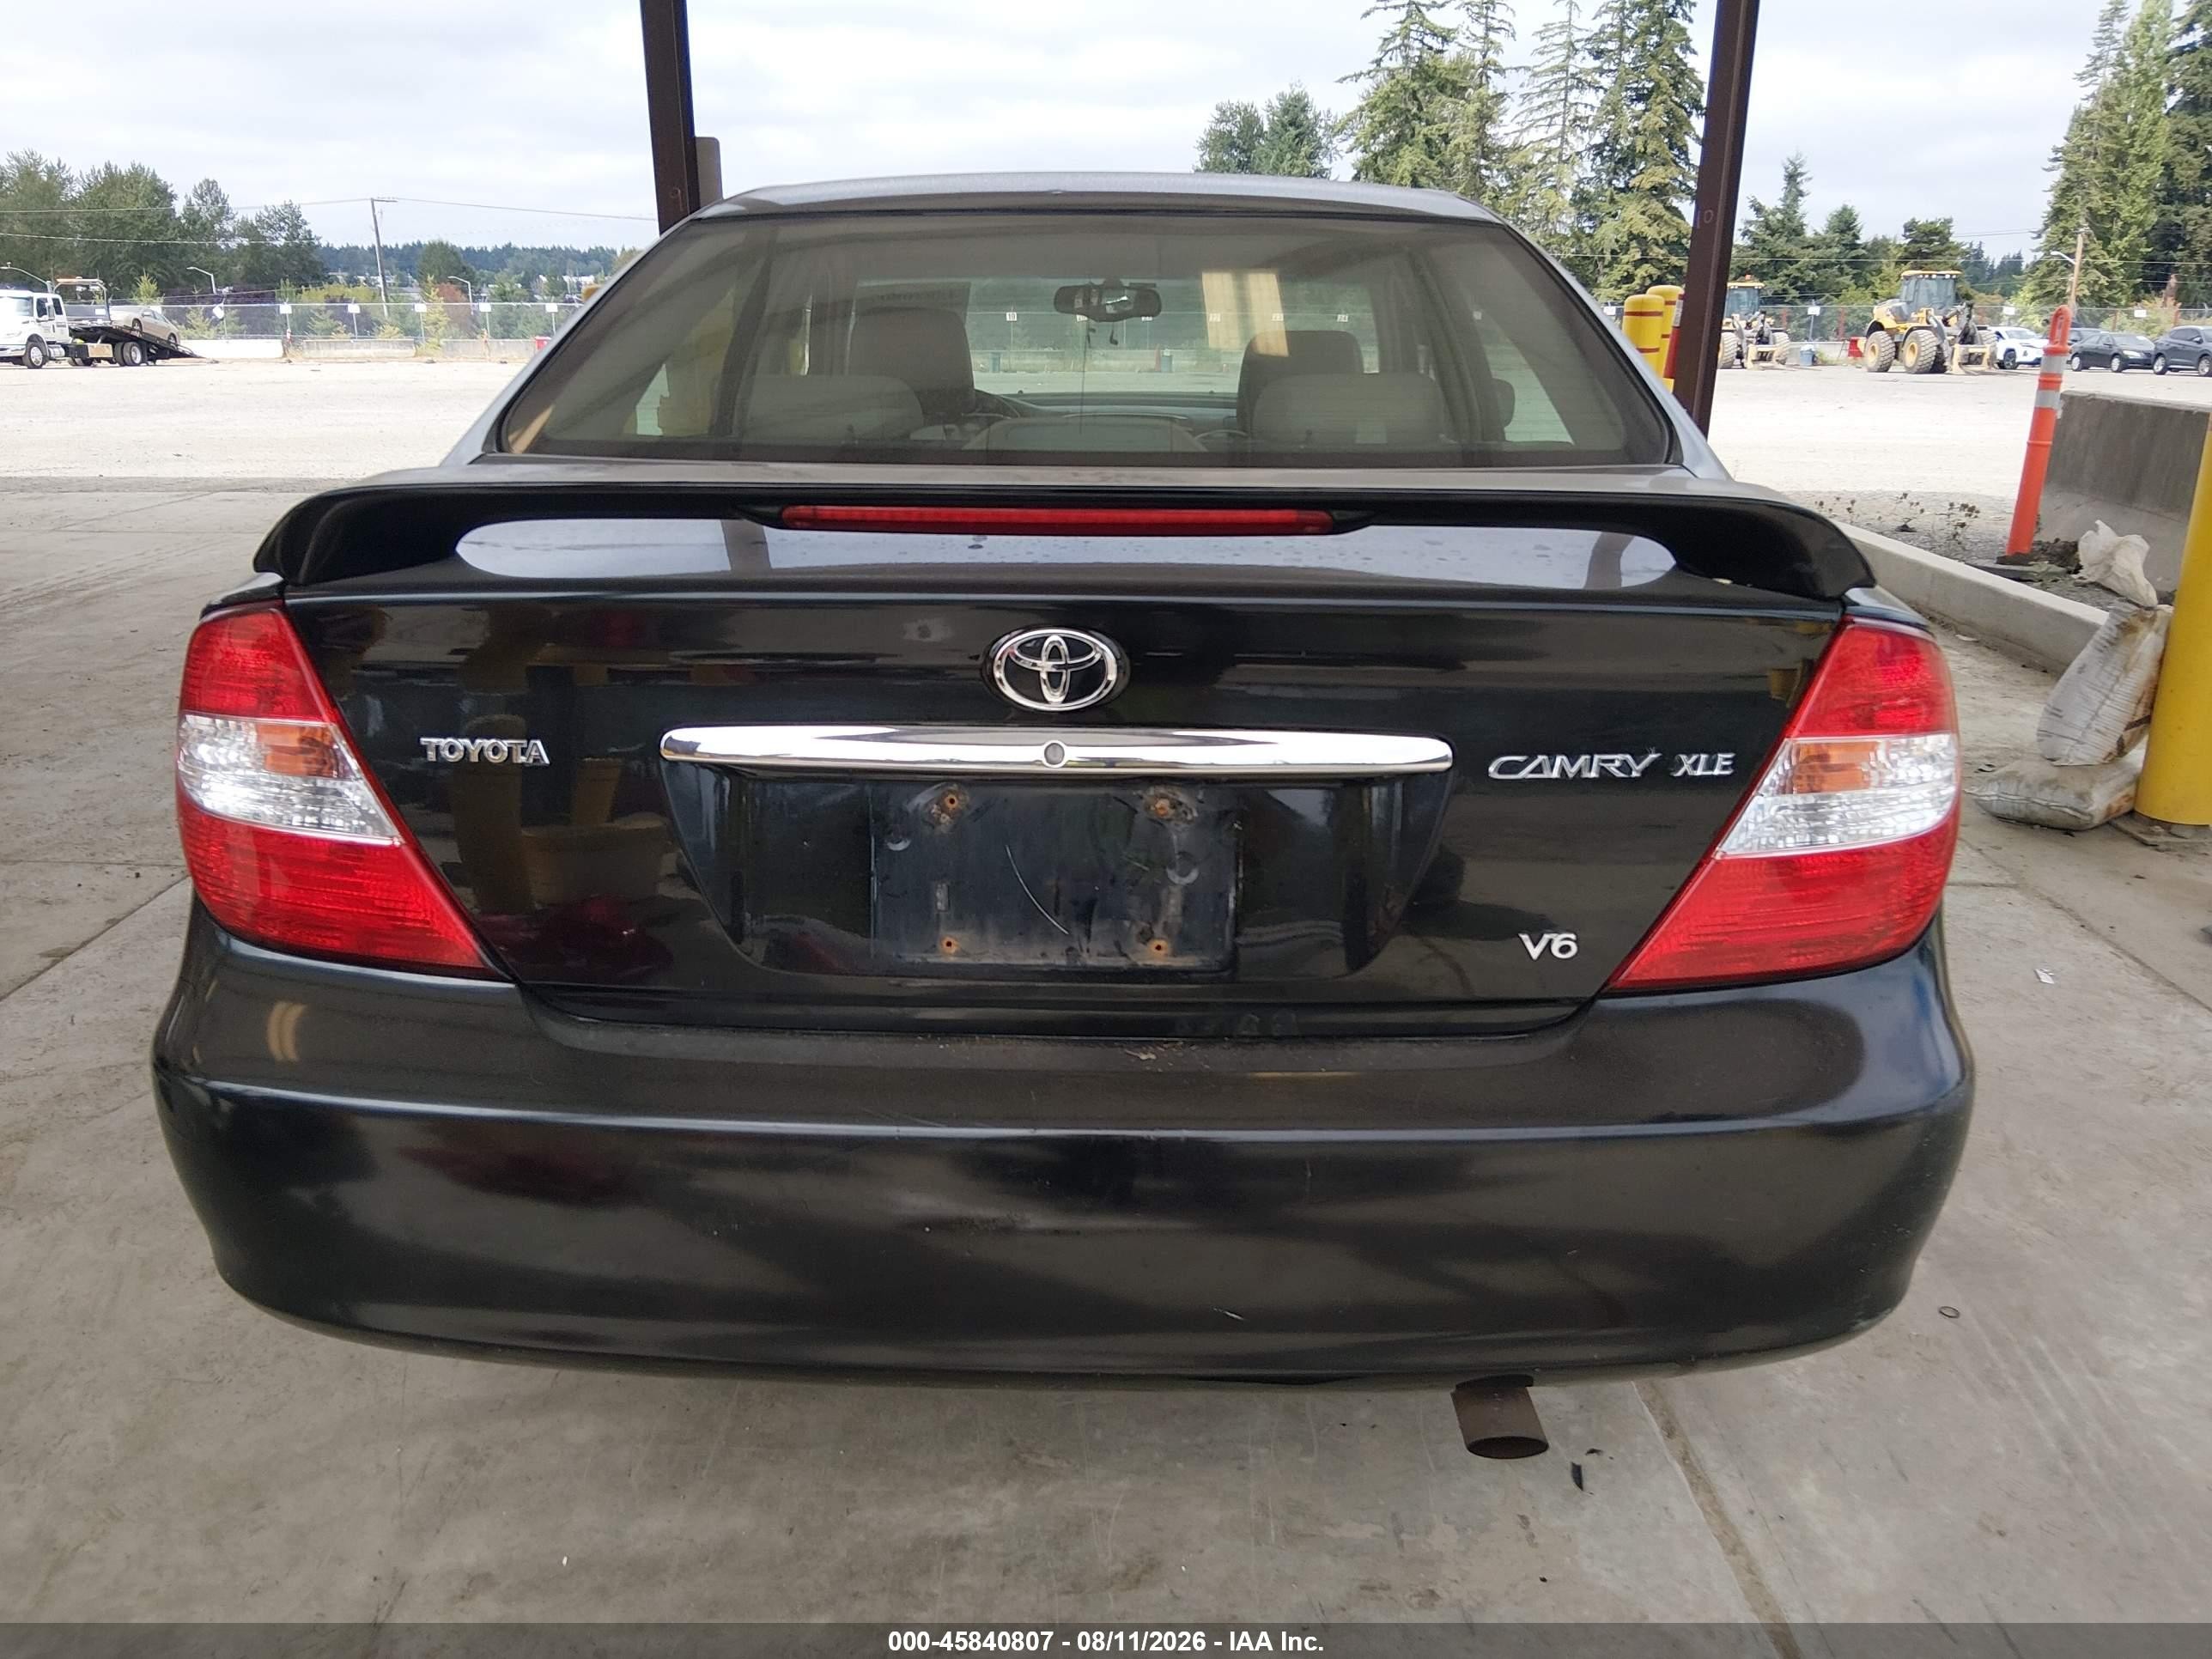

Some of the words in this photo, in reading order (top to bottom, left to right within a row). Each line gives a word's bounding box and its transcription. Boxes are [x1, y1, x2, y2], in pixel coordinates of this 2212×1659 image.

[420, 737, 550, 766] TOYOTA
[1488, 752, 1662, 779] CAMRY
[1670, 752, 1735, 777] XLE
[1518, 933, 1577, 961] V6
